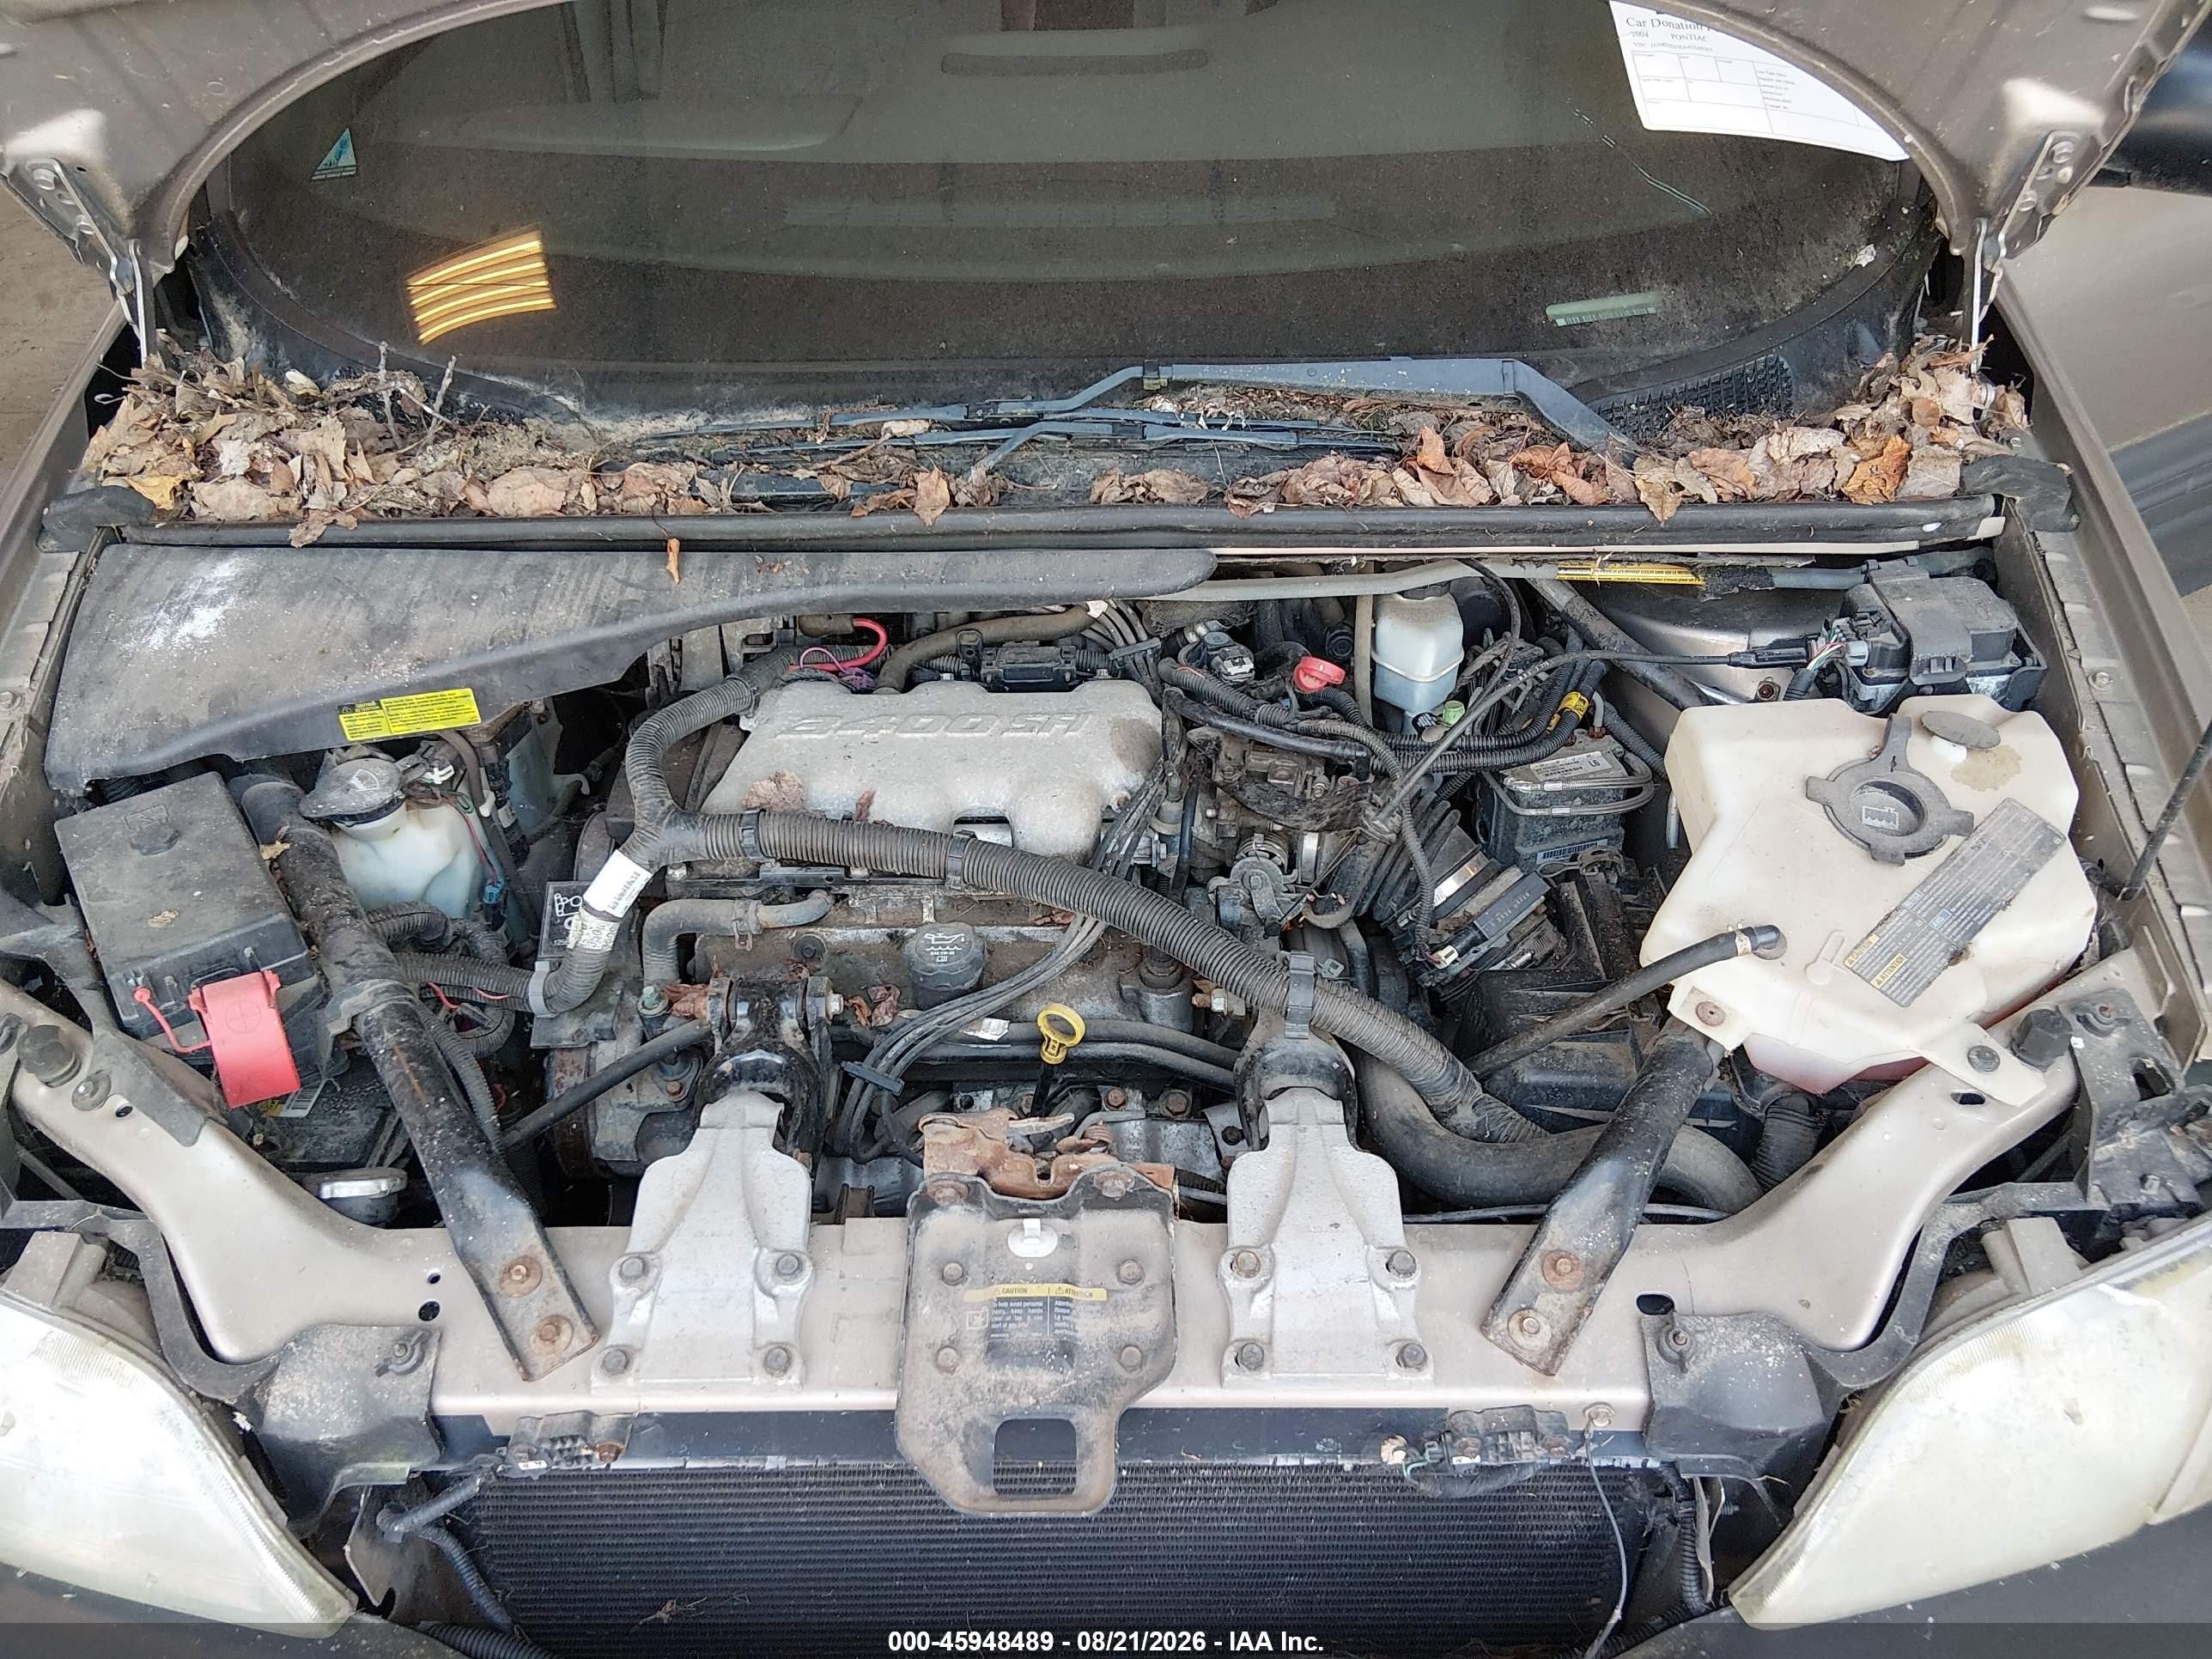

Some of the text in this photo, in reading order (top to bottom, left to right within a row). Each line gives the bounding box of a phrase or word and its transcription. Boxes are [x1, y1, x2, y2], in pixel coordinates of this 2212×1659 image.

[1626, 17, 1646, 27] Car
[1650, 18, 1703, 32] Donation
[1671, 33, 1708, 42] PONTIAC
[775, 712, 1093, 739] 3400 SFI
[1881, 954, 1906, 981] ATTENTION
[1065, 1287, 1093, 1297] ATTENTION
